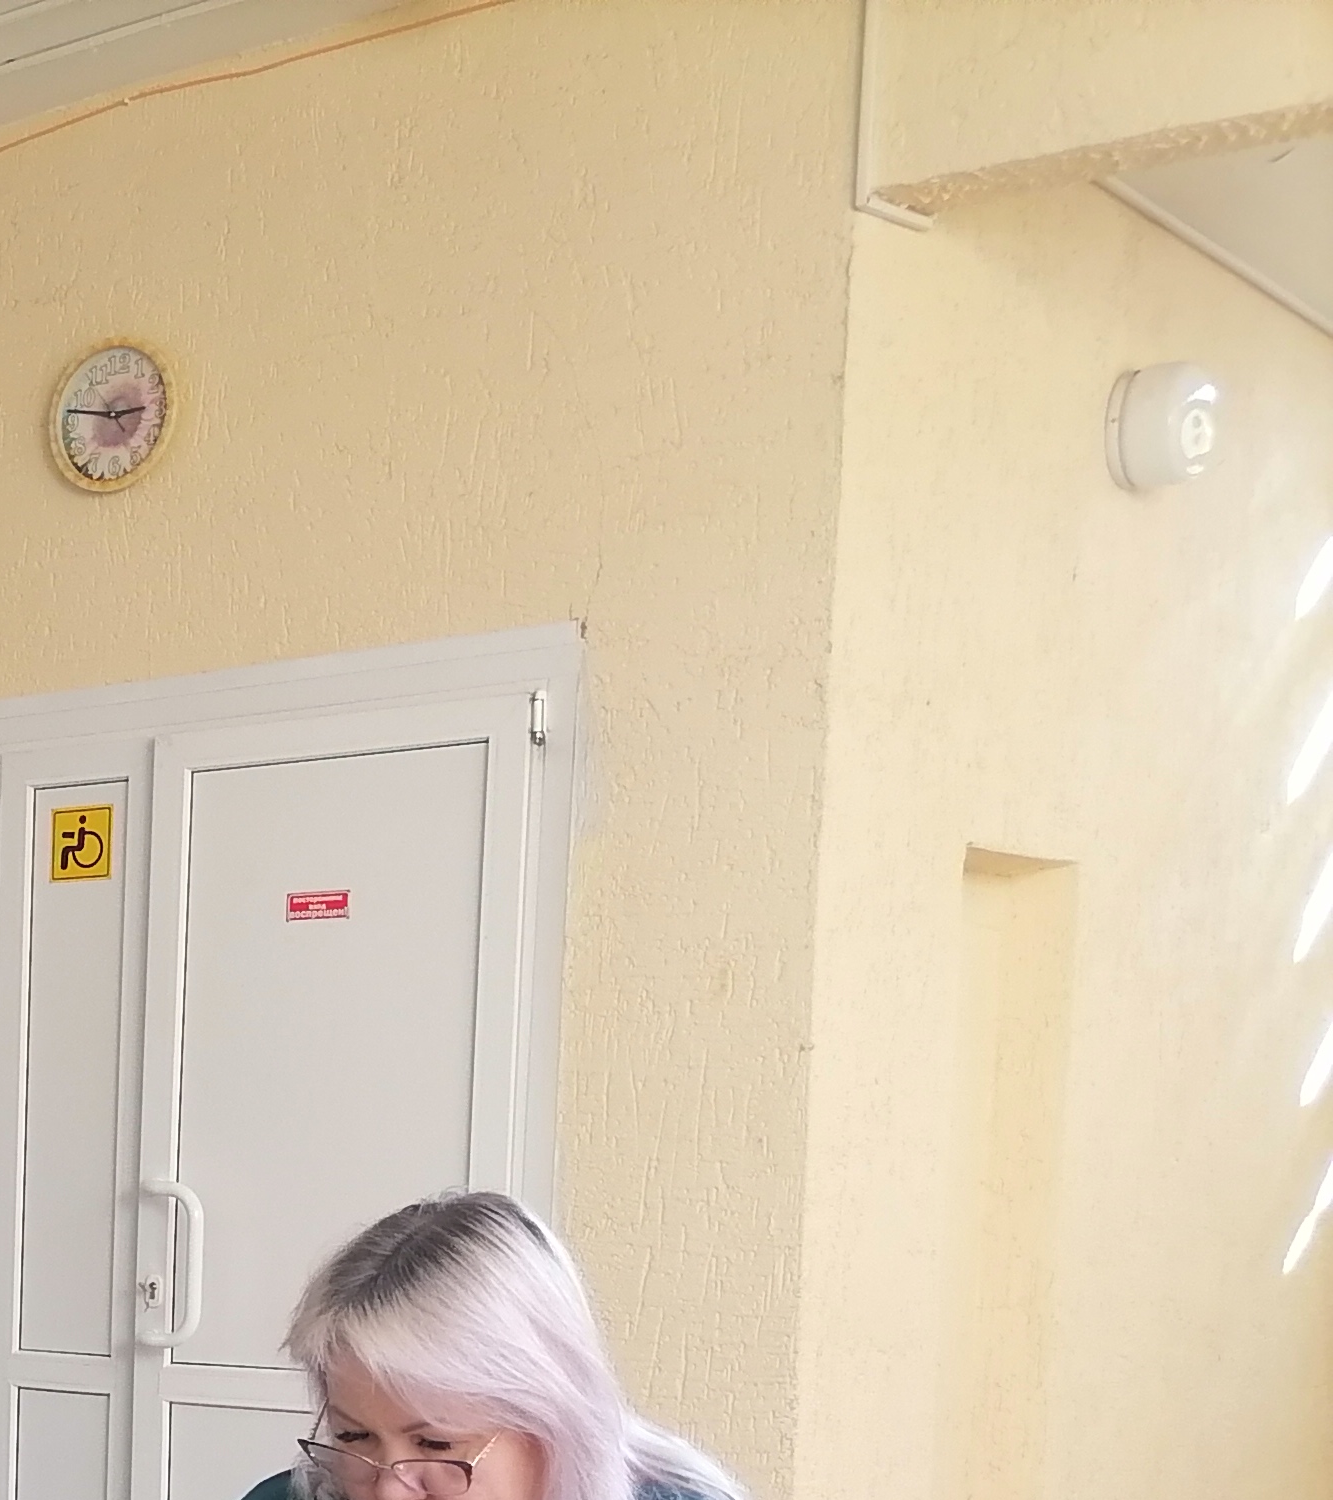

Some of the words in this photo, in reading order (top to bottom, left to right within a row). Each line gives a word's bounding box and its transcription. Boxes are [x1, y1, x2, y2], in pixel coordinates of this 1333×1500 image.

[108, 353, 131, 376] 12
[134, 358, 145, 379] 1
[89, 364, 109, 387] 11
[148, 373, 160, 394] 2
[74, 387, 96, 409] 10
[108, 455, 121, 476] 6
